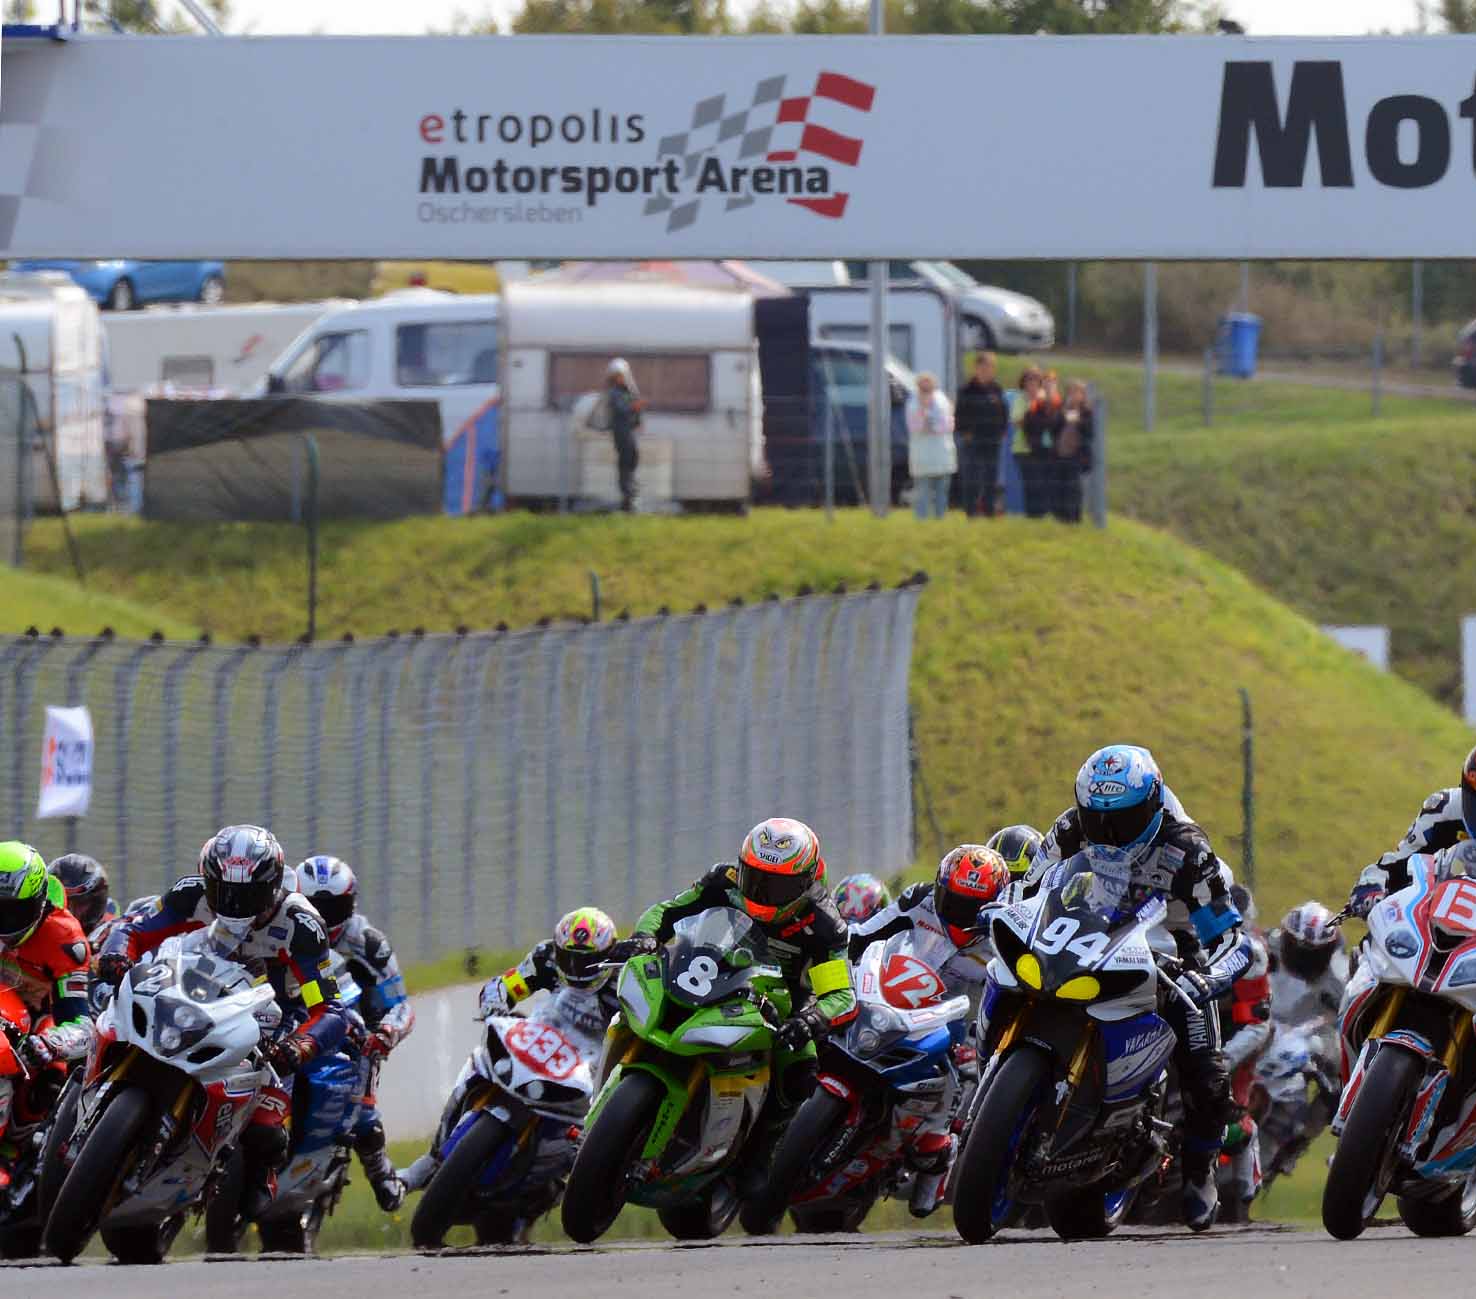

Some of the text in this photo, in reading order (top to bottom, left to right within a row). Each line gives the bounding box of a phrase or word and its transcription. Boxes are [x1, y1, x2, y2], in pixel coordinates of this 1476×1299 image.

[419, 109, 646, 148] etropolis
[419, 157, 830, 206] Motorsport Arena
[417, 201, 583, 225] Oschersleben
[1034, 916, 1112, 968] 94
[676, 954, 719, 998] 8
[510, 1027, 578, 1077] 333
